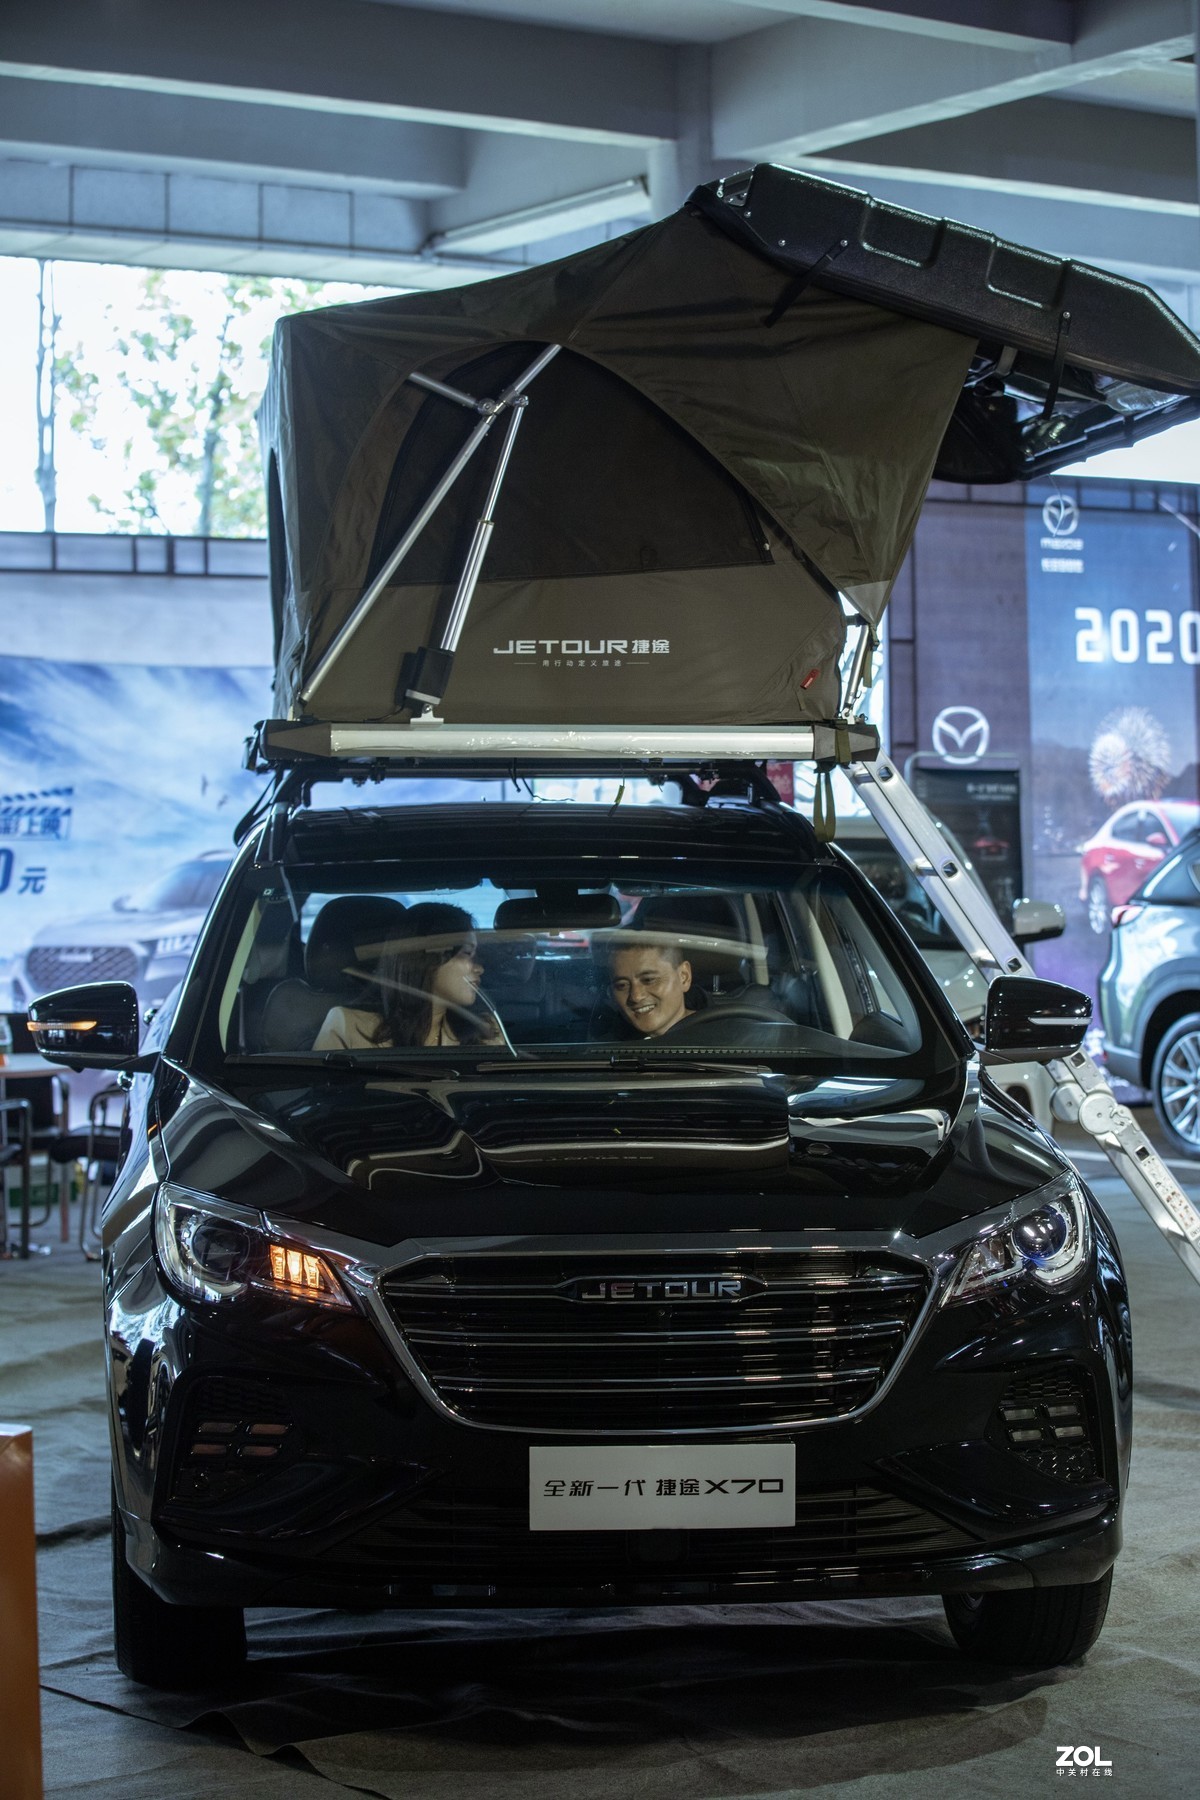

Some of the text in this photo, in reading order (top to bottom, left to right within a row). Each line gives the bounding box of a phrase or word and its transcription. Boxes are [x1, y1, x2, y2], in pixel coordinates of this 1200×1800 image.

[1075, 607, 1200, 665] 2020
[493, 639, 670, 654] JETOUR 捷途
[582, 1280, 742, 1299] JETOUR
[543, 1479, 646, 1497] 全新一代
